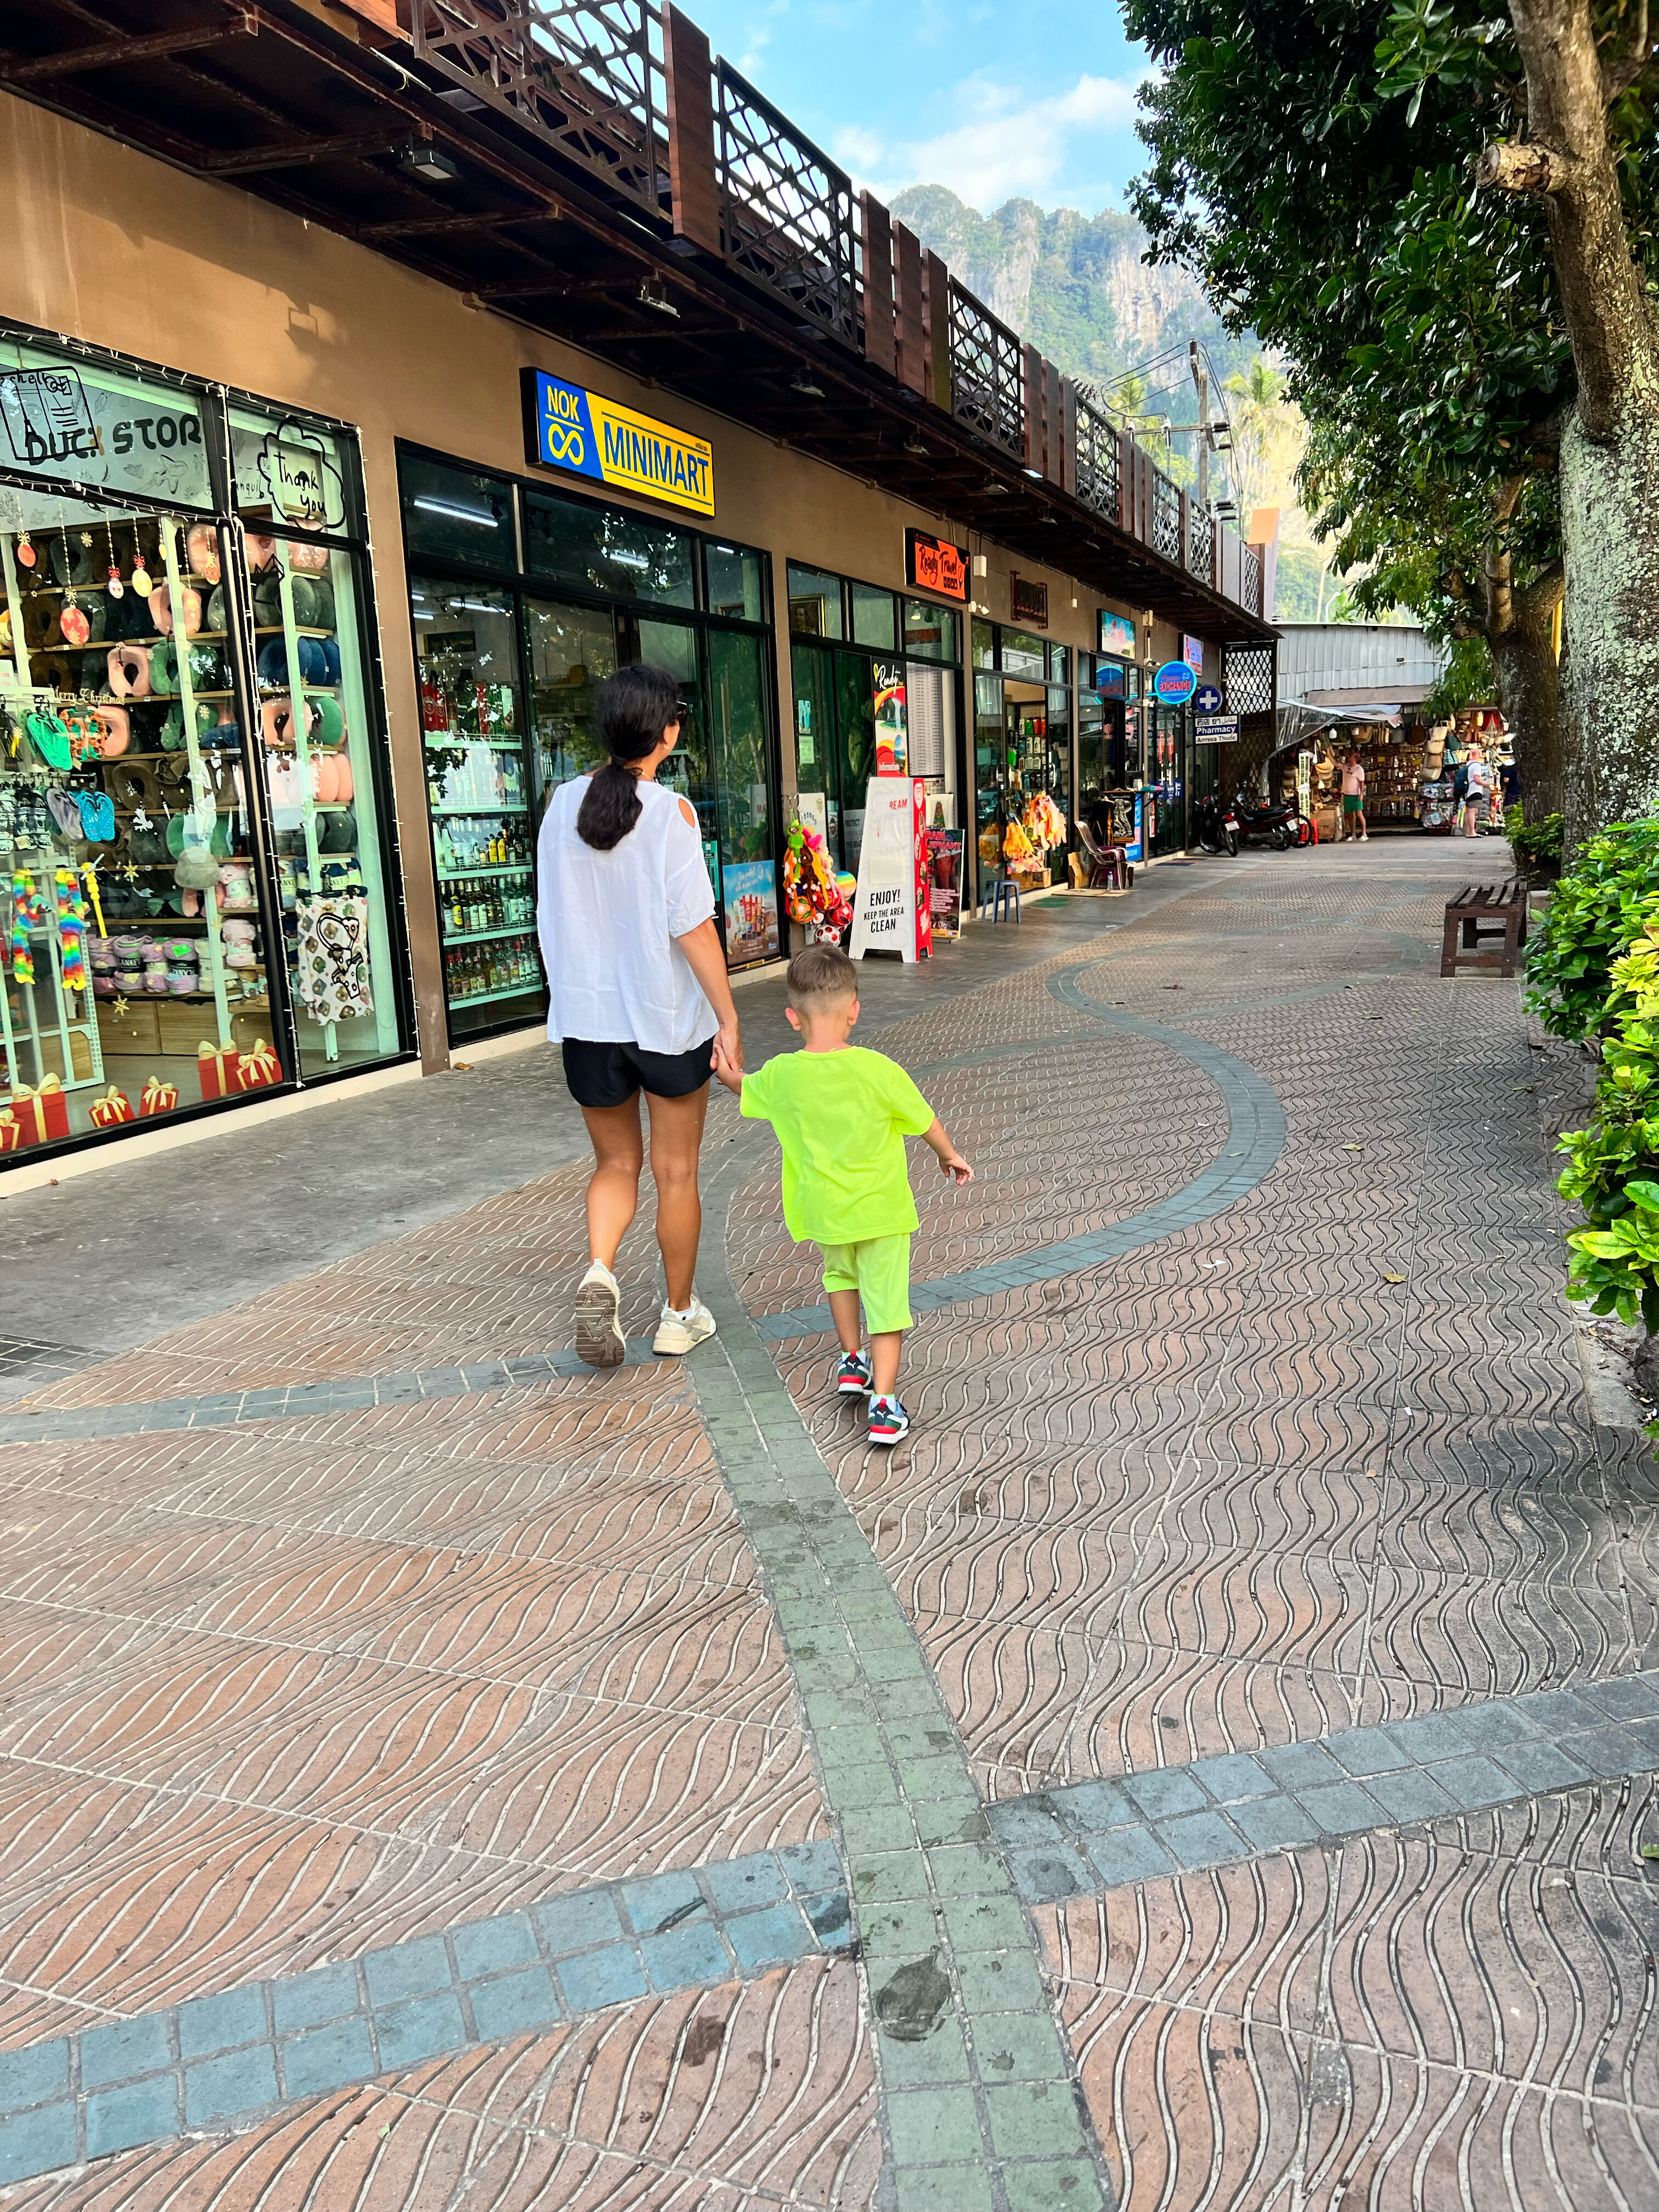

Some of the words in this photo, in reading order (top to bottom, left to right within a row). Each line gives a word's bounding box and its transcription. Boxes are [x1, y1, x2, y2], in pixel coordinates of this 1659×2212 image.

[547, 385, 580, 423] NOK
[112, 414, 202, 454] STOR
[603, 421, 709, 496] MINIMART
[300, 494, 327, 520] you
[919, 545, 938, 585] Ready
[939, 551, 957, 575] Travel
[1159, 680, 1191, 692] EXCHANGE
[80, 688, 126, 706] Christmas
[1197, 726, 1236, 735] Pharmacy
[926, 830, 945, 840] RABI
[870, 889, 900, 906] ENJOY!
[864, 911, 877, 921] KEEP
[879, 909, 888, 918] THE
[890, 907, 904, 916] AREA
[871, 918, 896, 933] CLEAN
